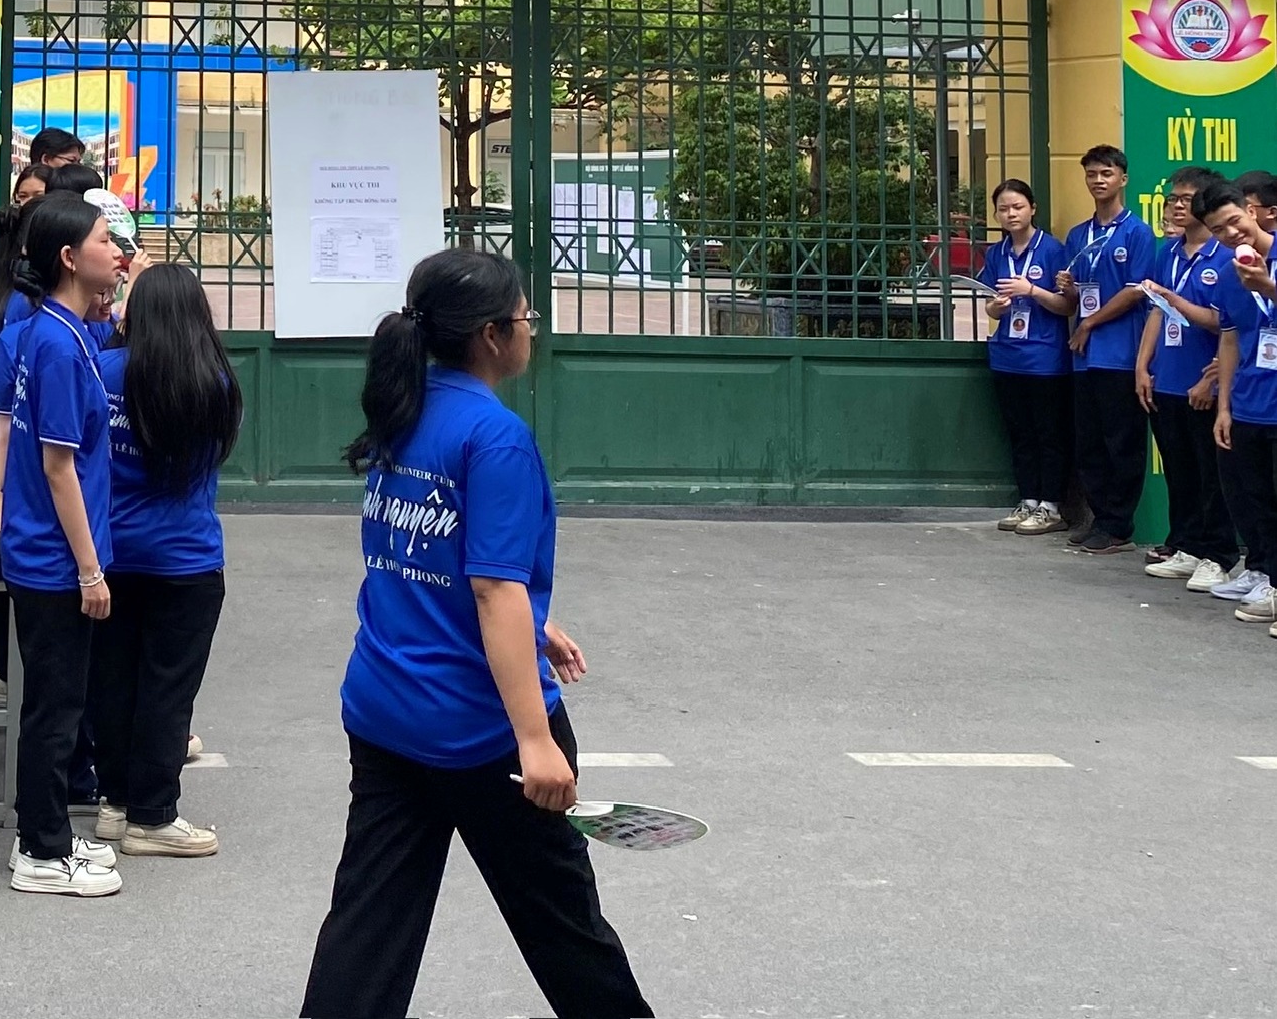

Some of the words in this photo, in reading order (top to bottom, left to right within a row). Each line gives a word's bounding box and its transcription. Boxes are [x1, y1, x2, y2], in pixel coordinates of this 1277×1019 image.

[1167, 107, 1195, 161] KỲ
[1202, 117, 1237, 162] THI
[403, 567, 451, 587] PHONG
